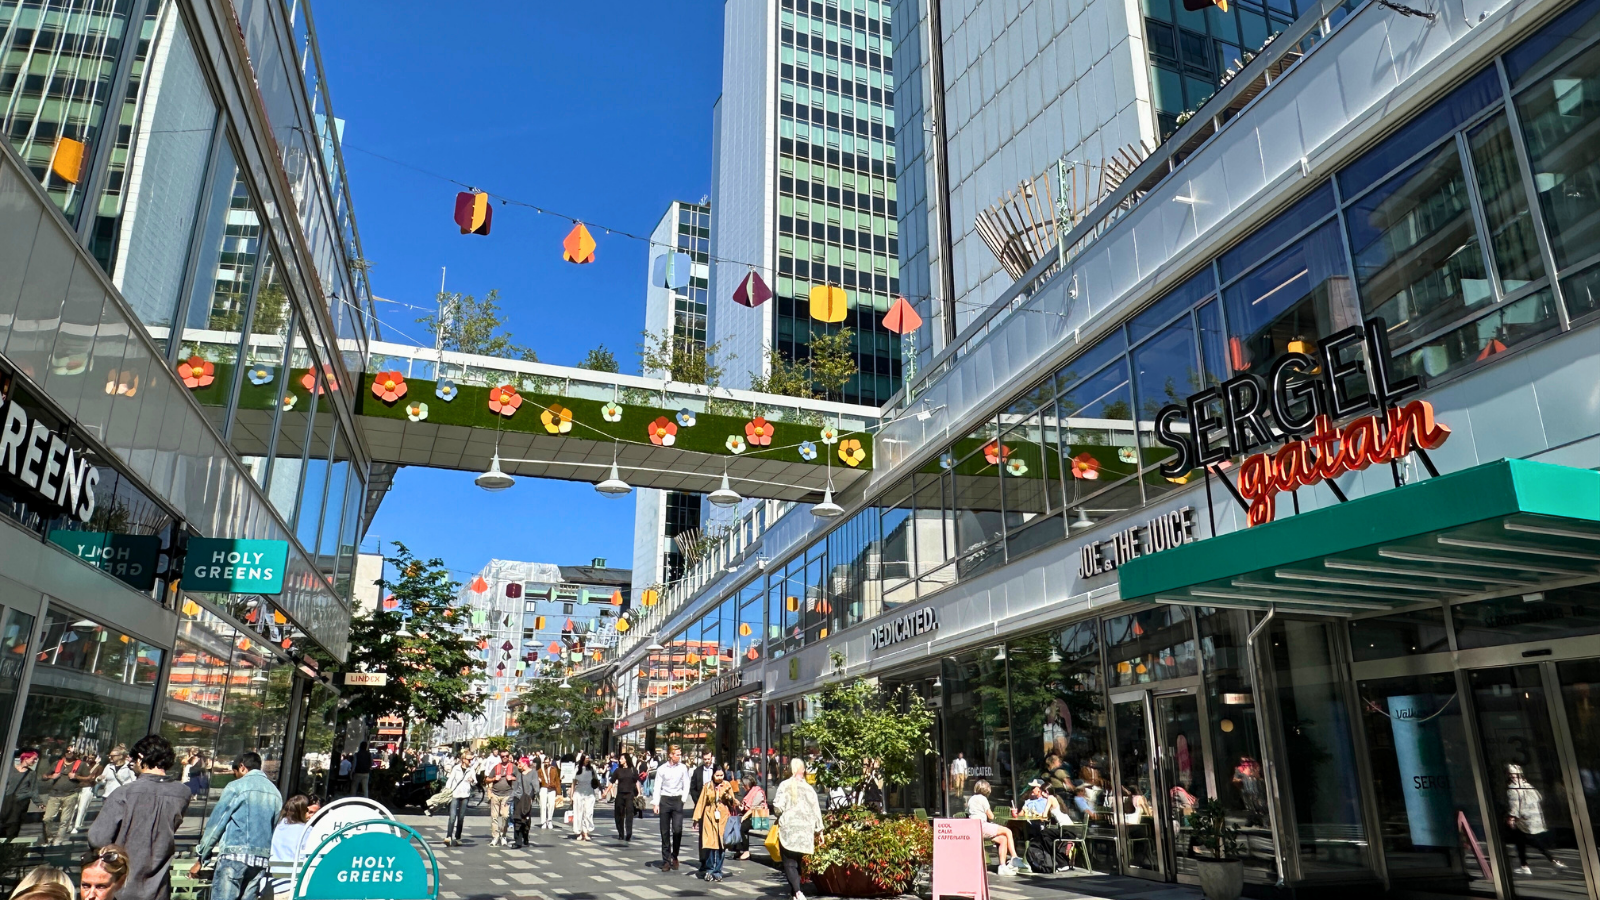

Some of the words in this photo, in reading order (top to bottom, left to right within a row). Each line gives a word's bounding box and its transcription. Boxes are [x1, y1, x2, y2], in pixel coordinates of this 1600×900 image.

[1154, 316, 1426, 478] SERGEL
[0, 396, 100, 522] REENS
[1237, 399, 1451, 528] gatan
[212, 550, 265, 566] HOLY
[1078, 540, 1104, 579] JOE
[1104, 559, 1113, 571] &
[1110, 525, 1141, 567] THE
[1145, 505, 1195, 556] JUICE
[194, 565, 274, 582] GREENS
[870, 606, 940, 652] DEDICATED.
[337, 870, 404, 883] GREENS
[352, 856, 396, 869] HOLY
